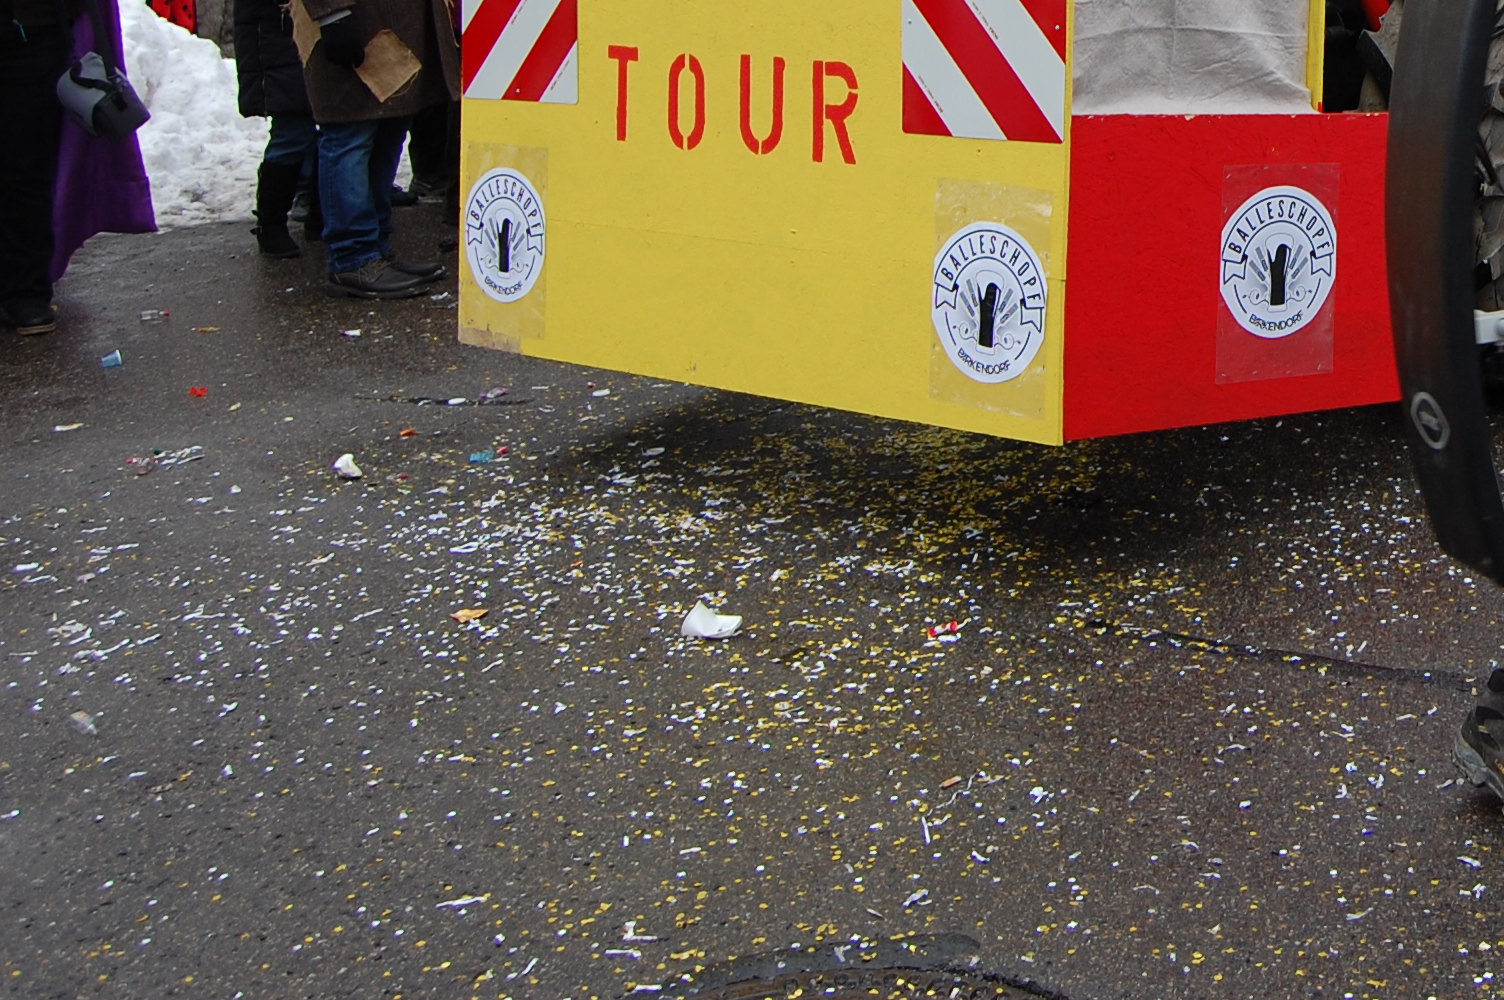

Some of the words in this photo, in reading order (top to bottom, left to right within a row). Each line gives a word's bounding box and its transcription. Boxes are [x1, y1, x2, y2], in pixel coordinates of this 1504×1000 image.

[607, 45, 859, 165] TOUR
[470, 178, 542, 230] BALLESCHOPF
[1228, 199, 1331, 255] BALLESCHOPF
[940, 234, 1042, 302] BALLESCHOPF
[1248, 310, 1304, 331] BIRKENDORF
[957, 347, 1011, 375] BIRKENDORF
